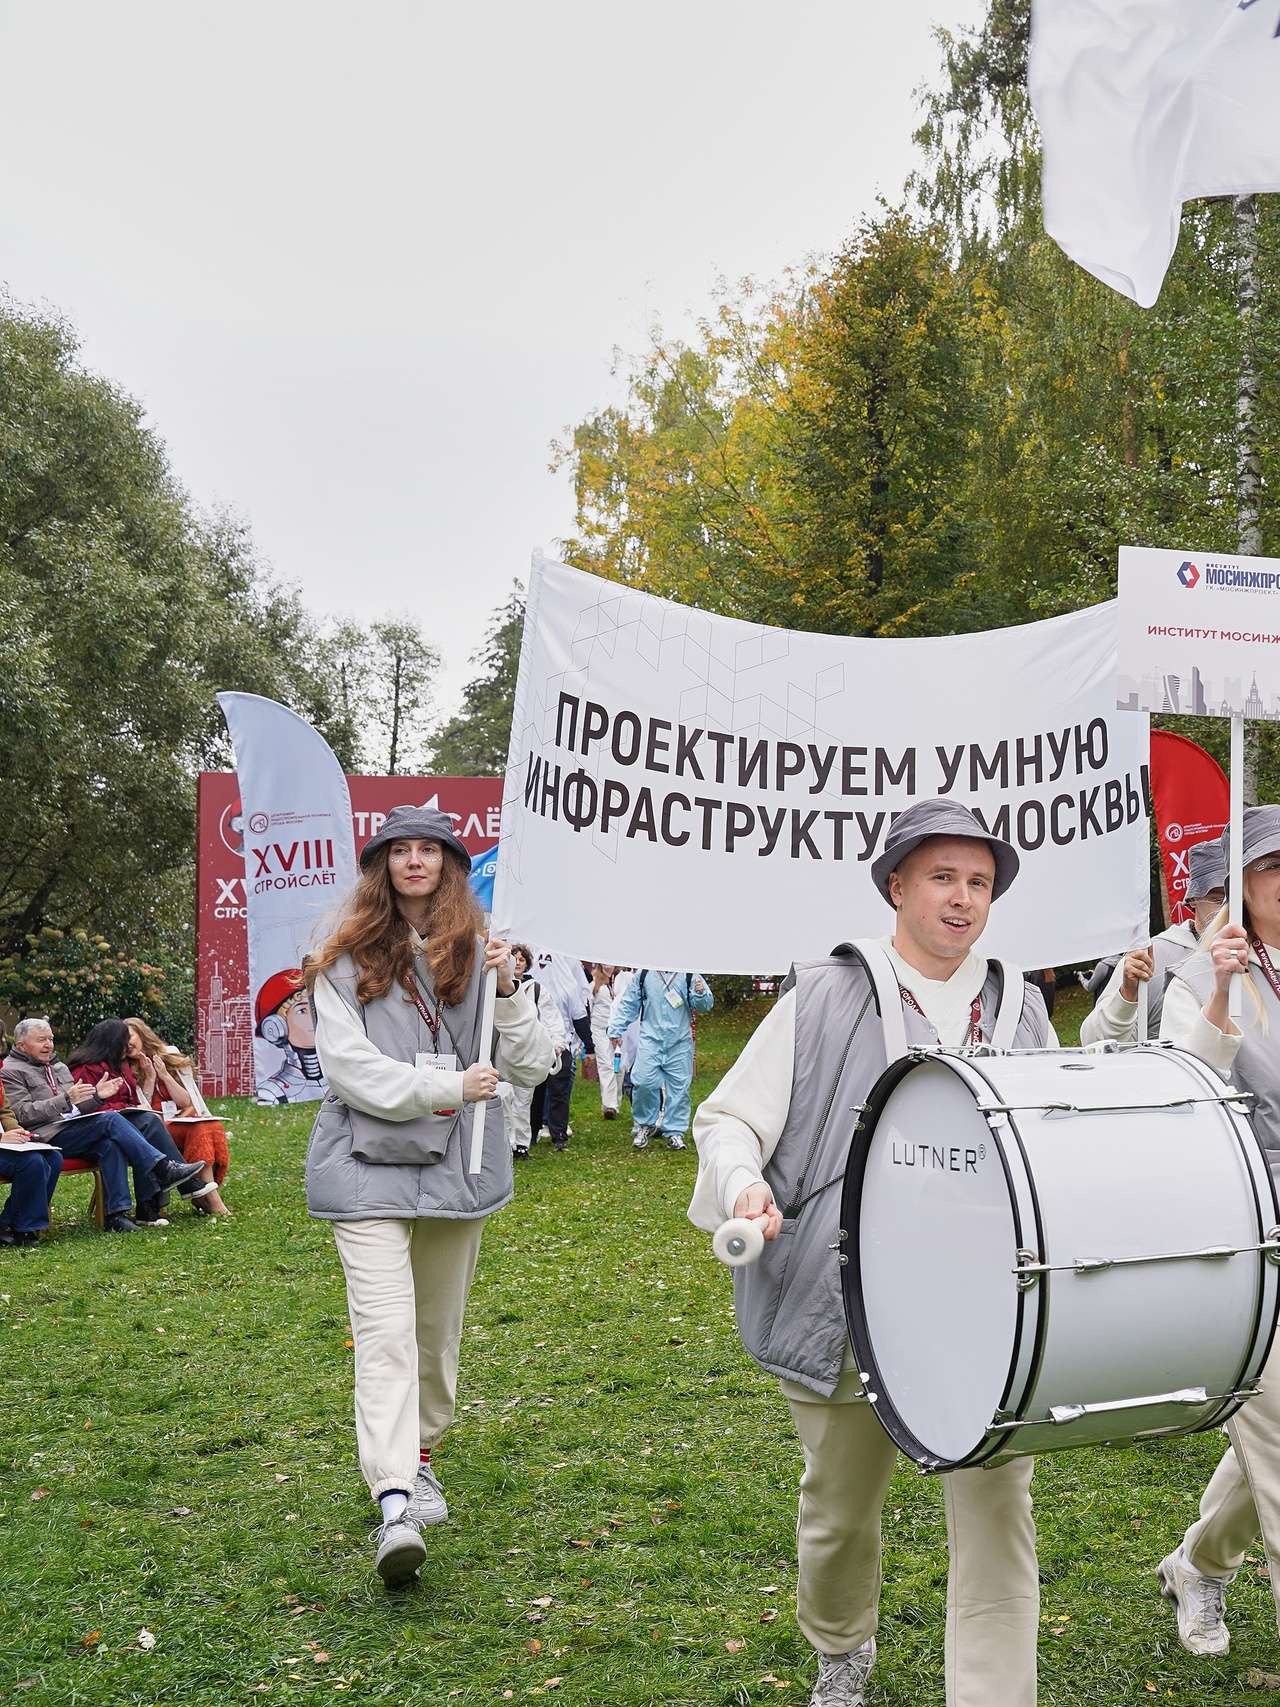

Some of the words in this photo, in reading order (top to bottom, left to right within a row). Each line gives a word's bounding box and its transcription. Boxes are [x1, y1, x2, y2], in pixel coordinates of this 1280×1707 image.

[1147, 625, 1217, 640] ИНСТИТУТ
[555, 690, 916, 797] ПРОЕКТИРУЕМ
[935, 717, 1109, 796] УМНУЮ
[524, 750, 902, 862] ИНФРАСТРУКТУ
[251, 839, 334, 878] XVIII
[254, 870, 336, 894] СТРОЙСЛЁТ
